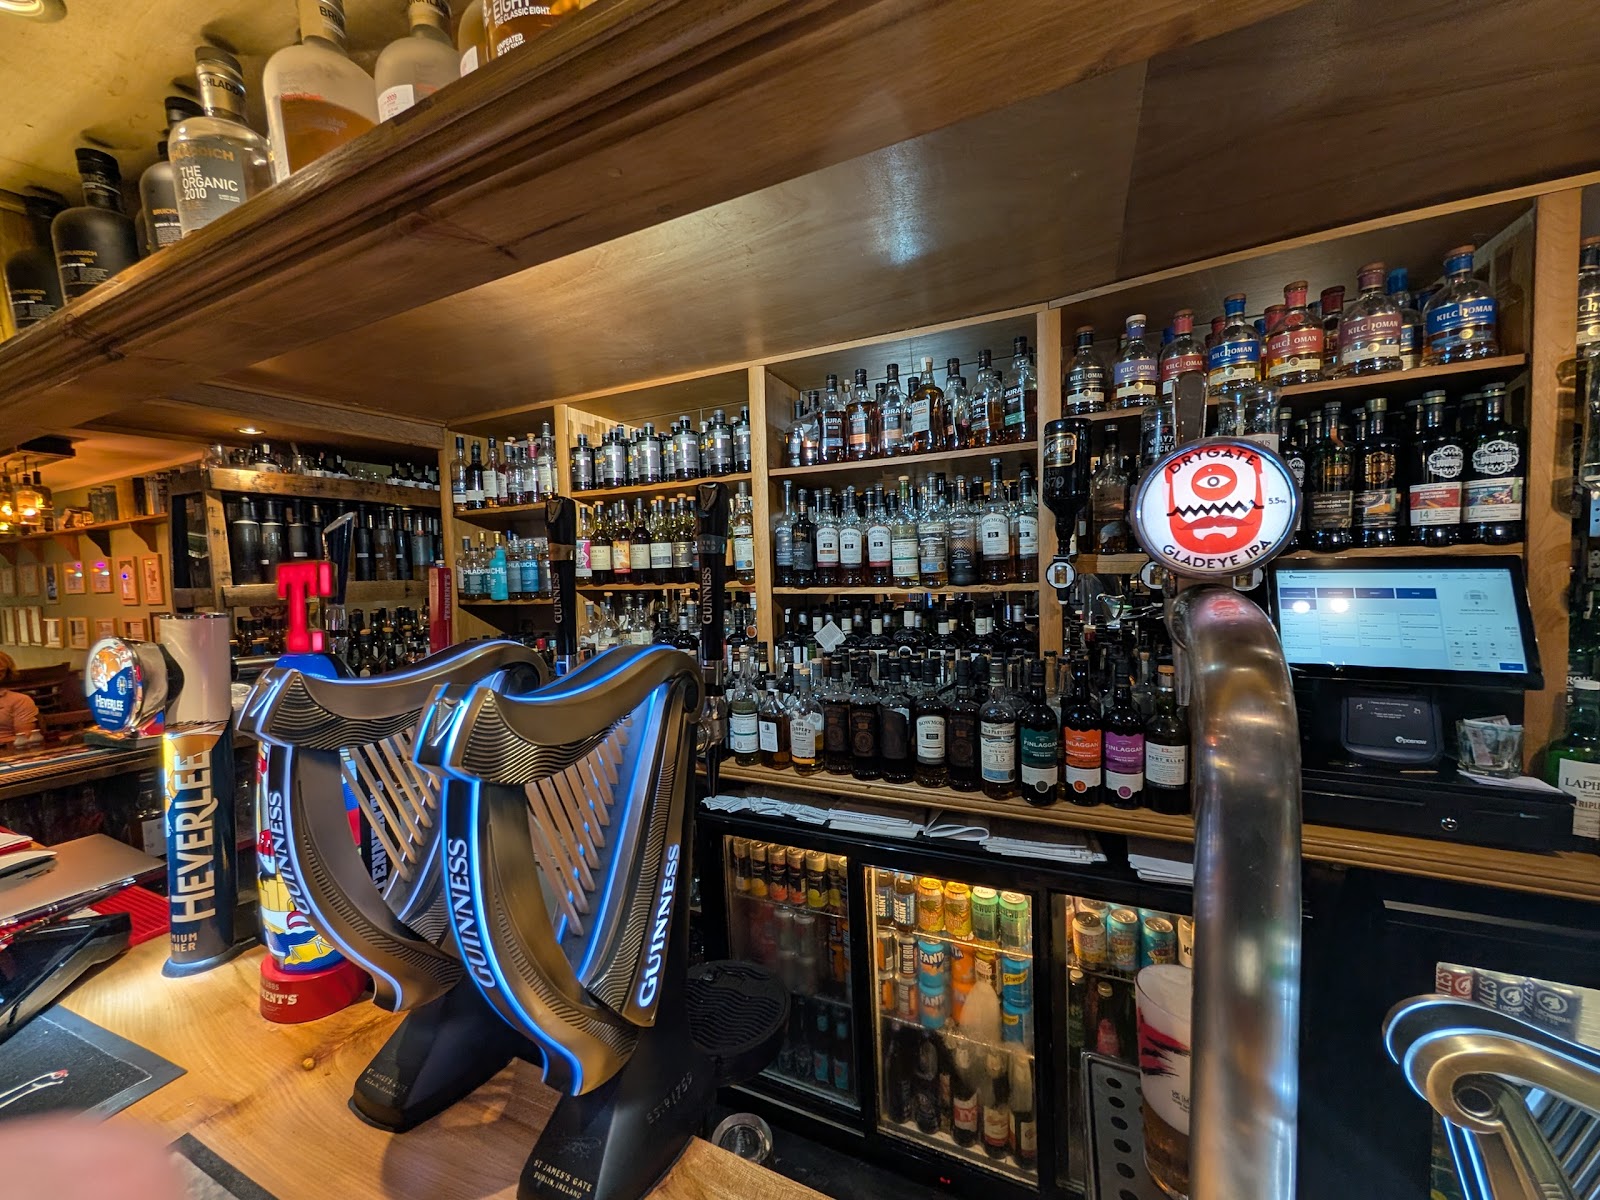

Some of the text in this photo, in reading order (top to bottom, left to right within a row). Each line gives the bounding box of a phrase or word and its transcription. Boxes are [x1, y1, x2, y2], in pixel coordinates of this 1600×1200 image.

[504, 8, 529, 22] CLASSIC
[496, 32, 524, 53] UNPEATED
[180, 165, 202, 178] THE
[182, 177, 239, 192] ORGANIC
[184, 188, 208, 201] 2010
[881, 405, 901, 416] JURA
[1167, 447, 1260, 475] DRYGATE
[1162, 539, 1273, 569] GLADEYE IPA
[443, 573, 451, 621] TENNENT'S
[552, 572, 563, 624] GUINNESS
[701, 566, 713, 625] GUINNESS
[94, 694, 124, 712] HEVERLEE
[171, 747, 219, 924] HEVERLEE
[269, 790, 312, 916] GUINNESS
[447, 837, 497, 989] GUINNESS
[637, 842, 681, 1009] GUINNESS
[899, 900, 907, 925] SAINT
[902, 944, 914, 960] BRU
[533, 1158, 594, 1193] ST JAMES'S GATE
